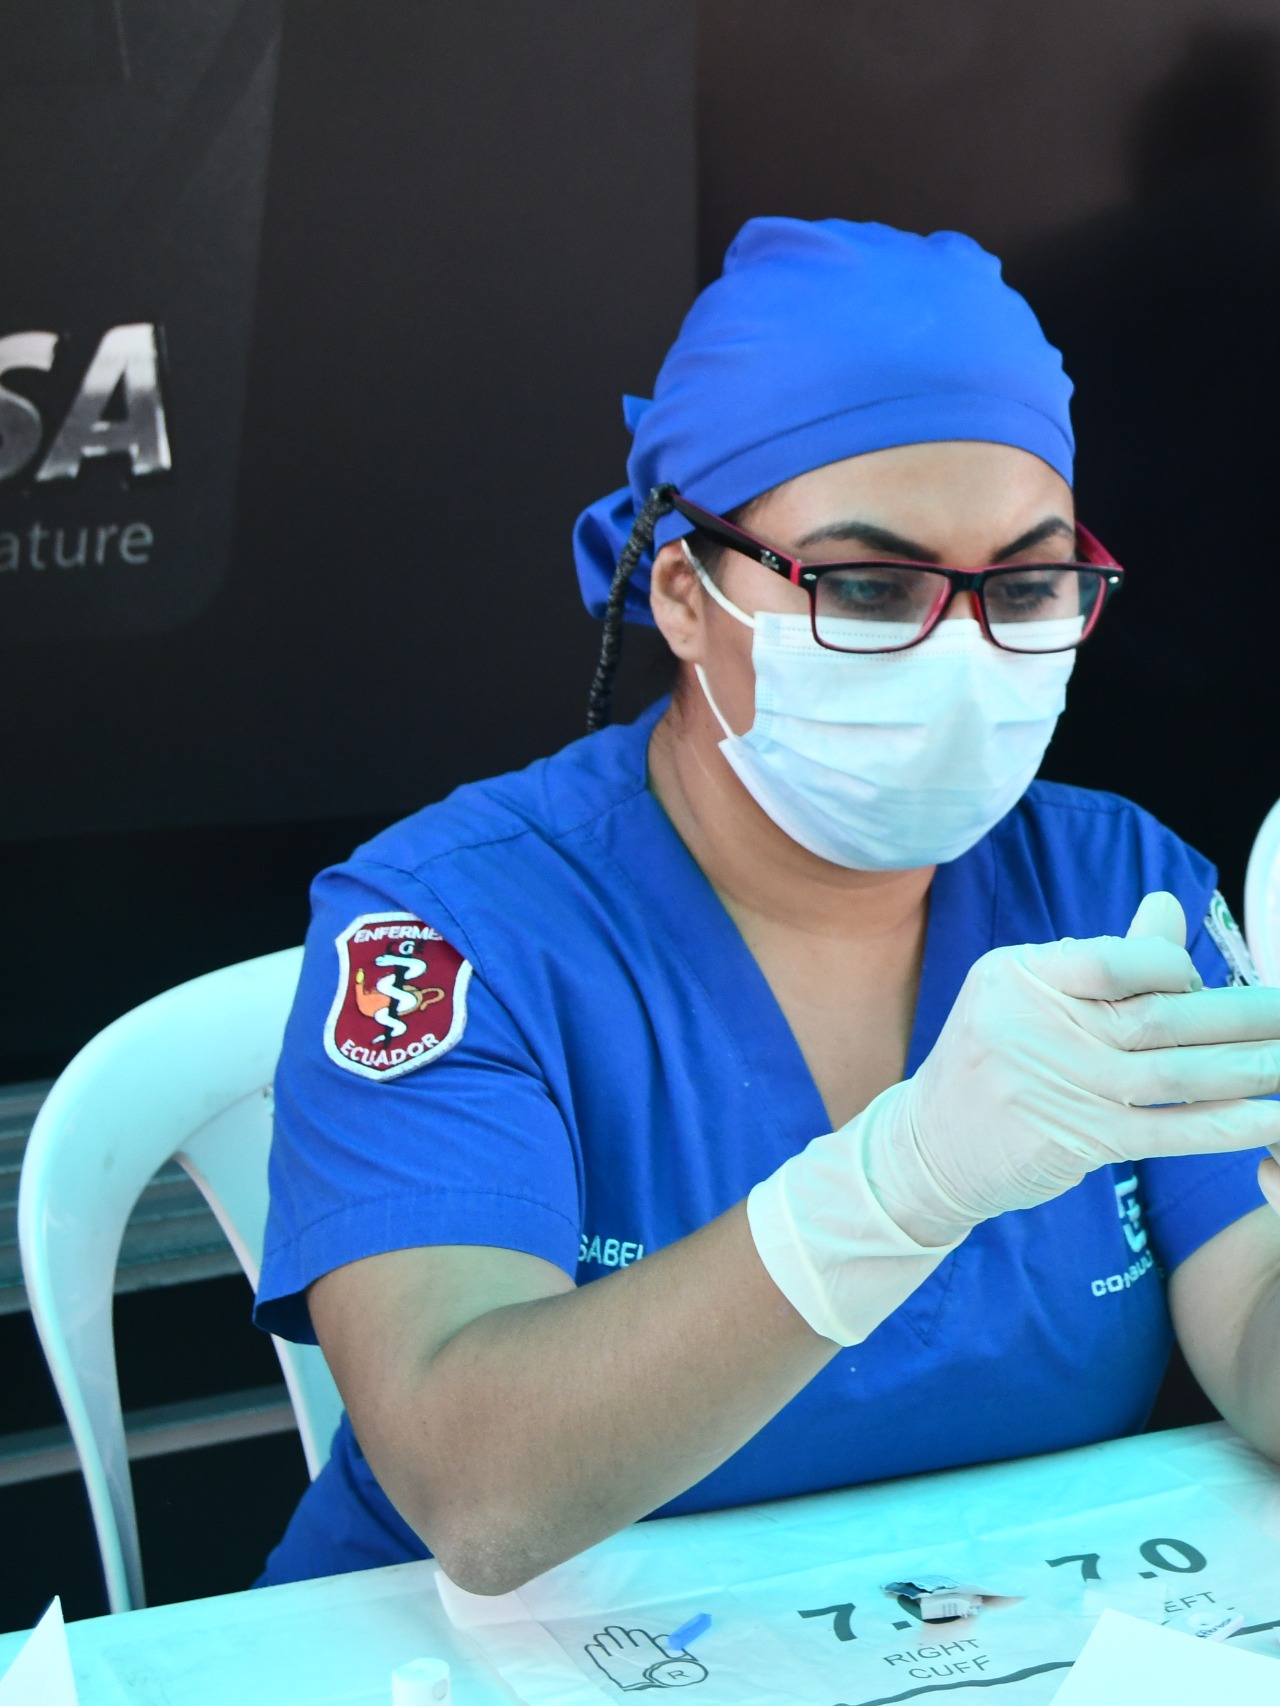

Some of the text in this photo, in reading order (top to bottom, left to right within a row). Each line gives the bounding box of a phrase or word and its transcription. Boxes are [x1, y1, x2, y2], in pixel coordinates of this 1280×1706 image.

[354, 925, 444, 944] ENFERME
[339, 1033, 440, 1067] ECUADOR
[1164, 1591, 1216, 1613] EFT
[883, 1639, 980, 1667] RIGHT
[908, 1654, 991, 1680] CUFF
